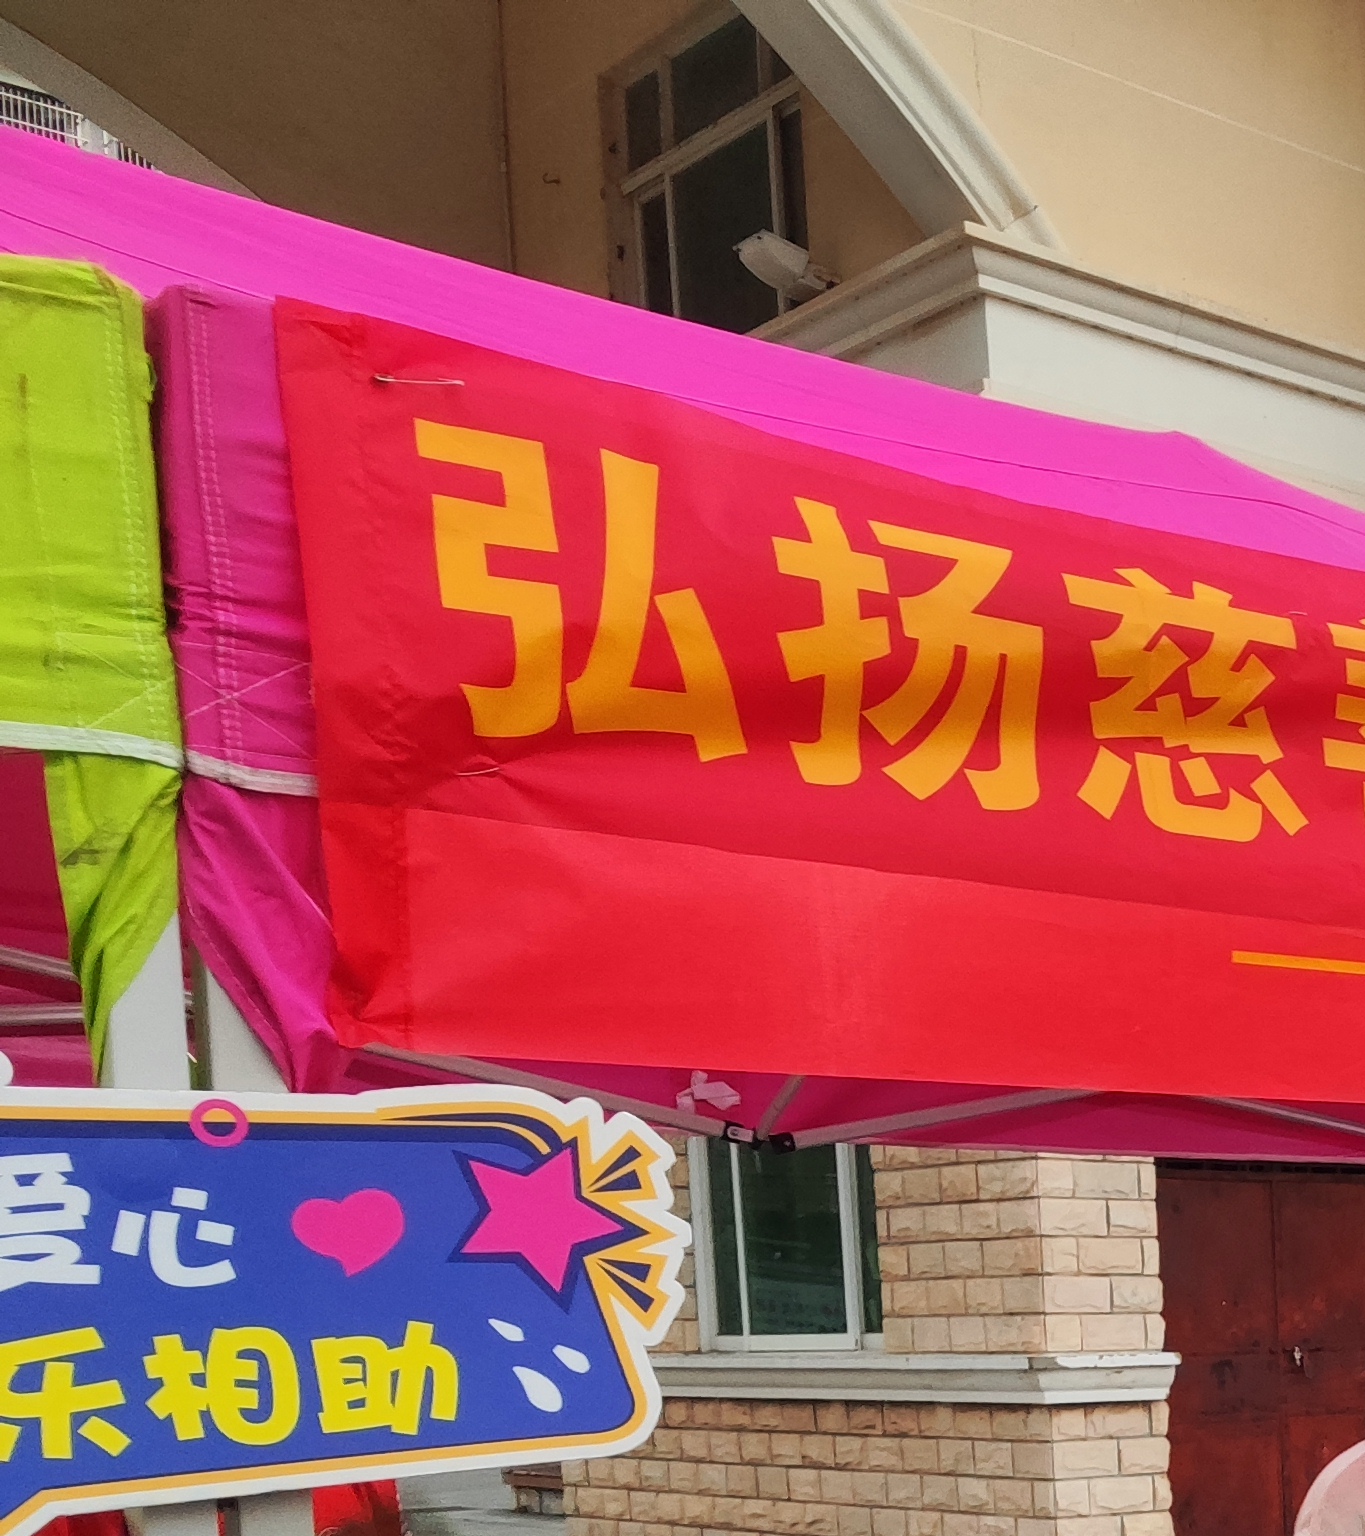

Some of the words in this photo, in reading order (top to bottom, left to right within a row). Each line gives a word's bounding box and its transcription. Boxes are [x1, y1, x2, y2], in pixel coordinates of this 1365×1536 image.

[0, 1151, 237, 1289] 爱心
[0, 1320, 459, 1462] 乐相助
